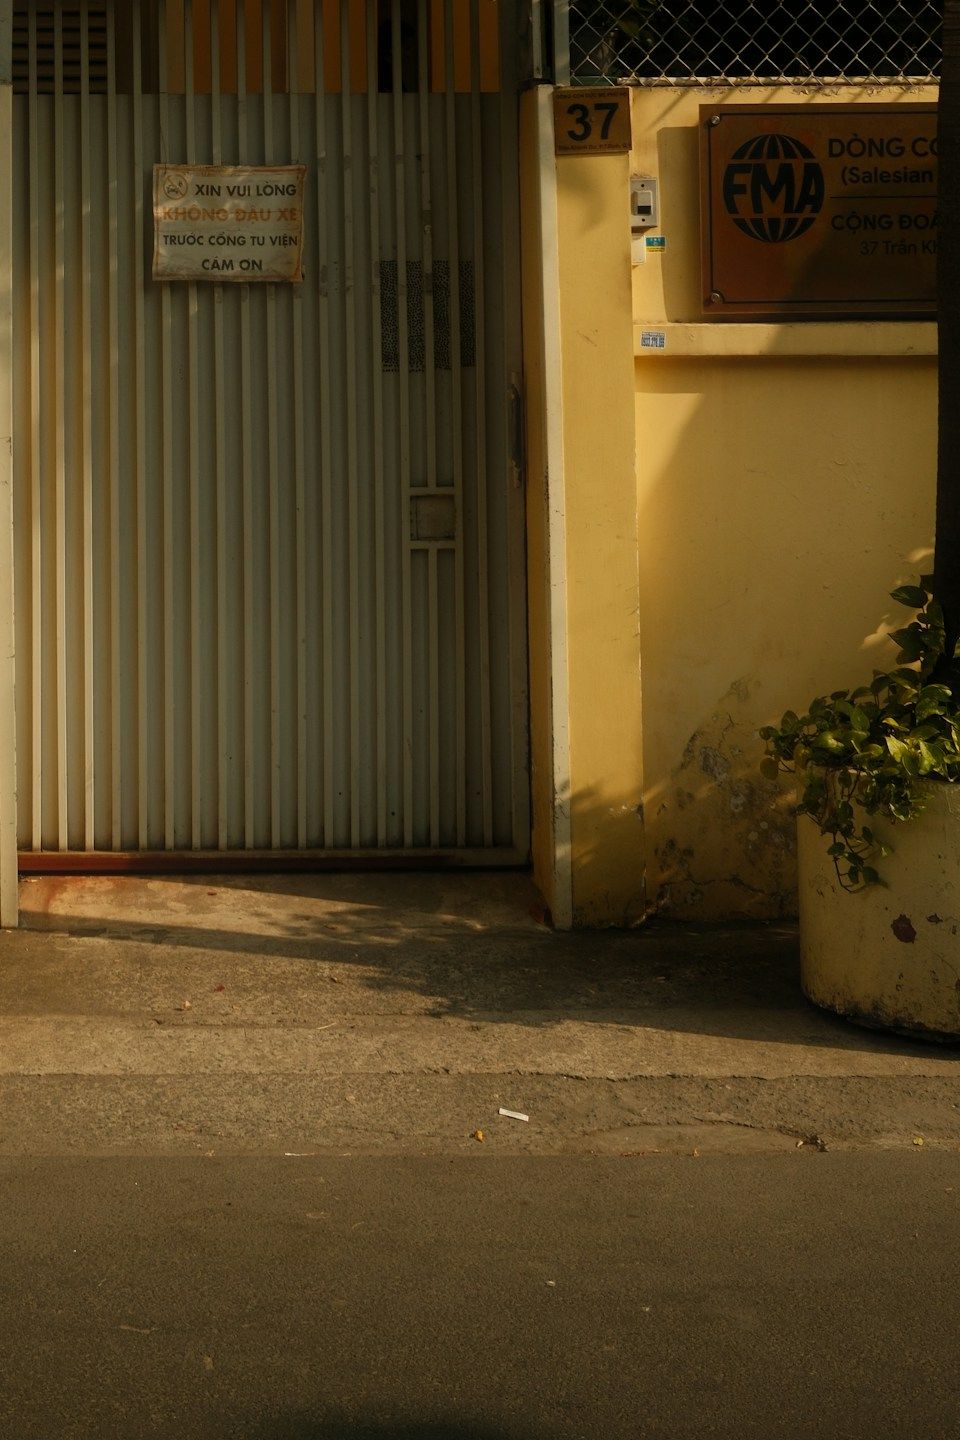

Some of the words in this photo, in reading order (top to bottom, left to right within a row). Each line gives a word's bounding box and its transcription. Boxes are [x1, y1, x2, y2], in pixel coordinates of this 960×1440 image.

[567, 102, 619, 141] 37
[828, 133, 906, 158] DÒNG
[841, 166, 933, 187] (Salesian
[195, 184, 221, 196] XIN
[226, 184, 251, 197] VUI
[256, 181, 297, 196] LÒNG
[723, 163, 825, 214] FMA
[162, 204, 230, 221] KHÔNG
[234, 205, 271, 224] ĐẬU
[276, 208, 298, 221] XE
[831, 211, 893, 235] CỘNG
[163, 233, 204, 246] TRƯỚC
[250, 235, 264, 246] TU
[269, 233, 298, 248] VIỆN
[859, 240, 879, 257] 37
[881, 238, 917, 255] Trần
